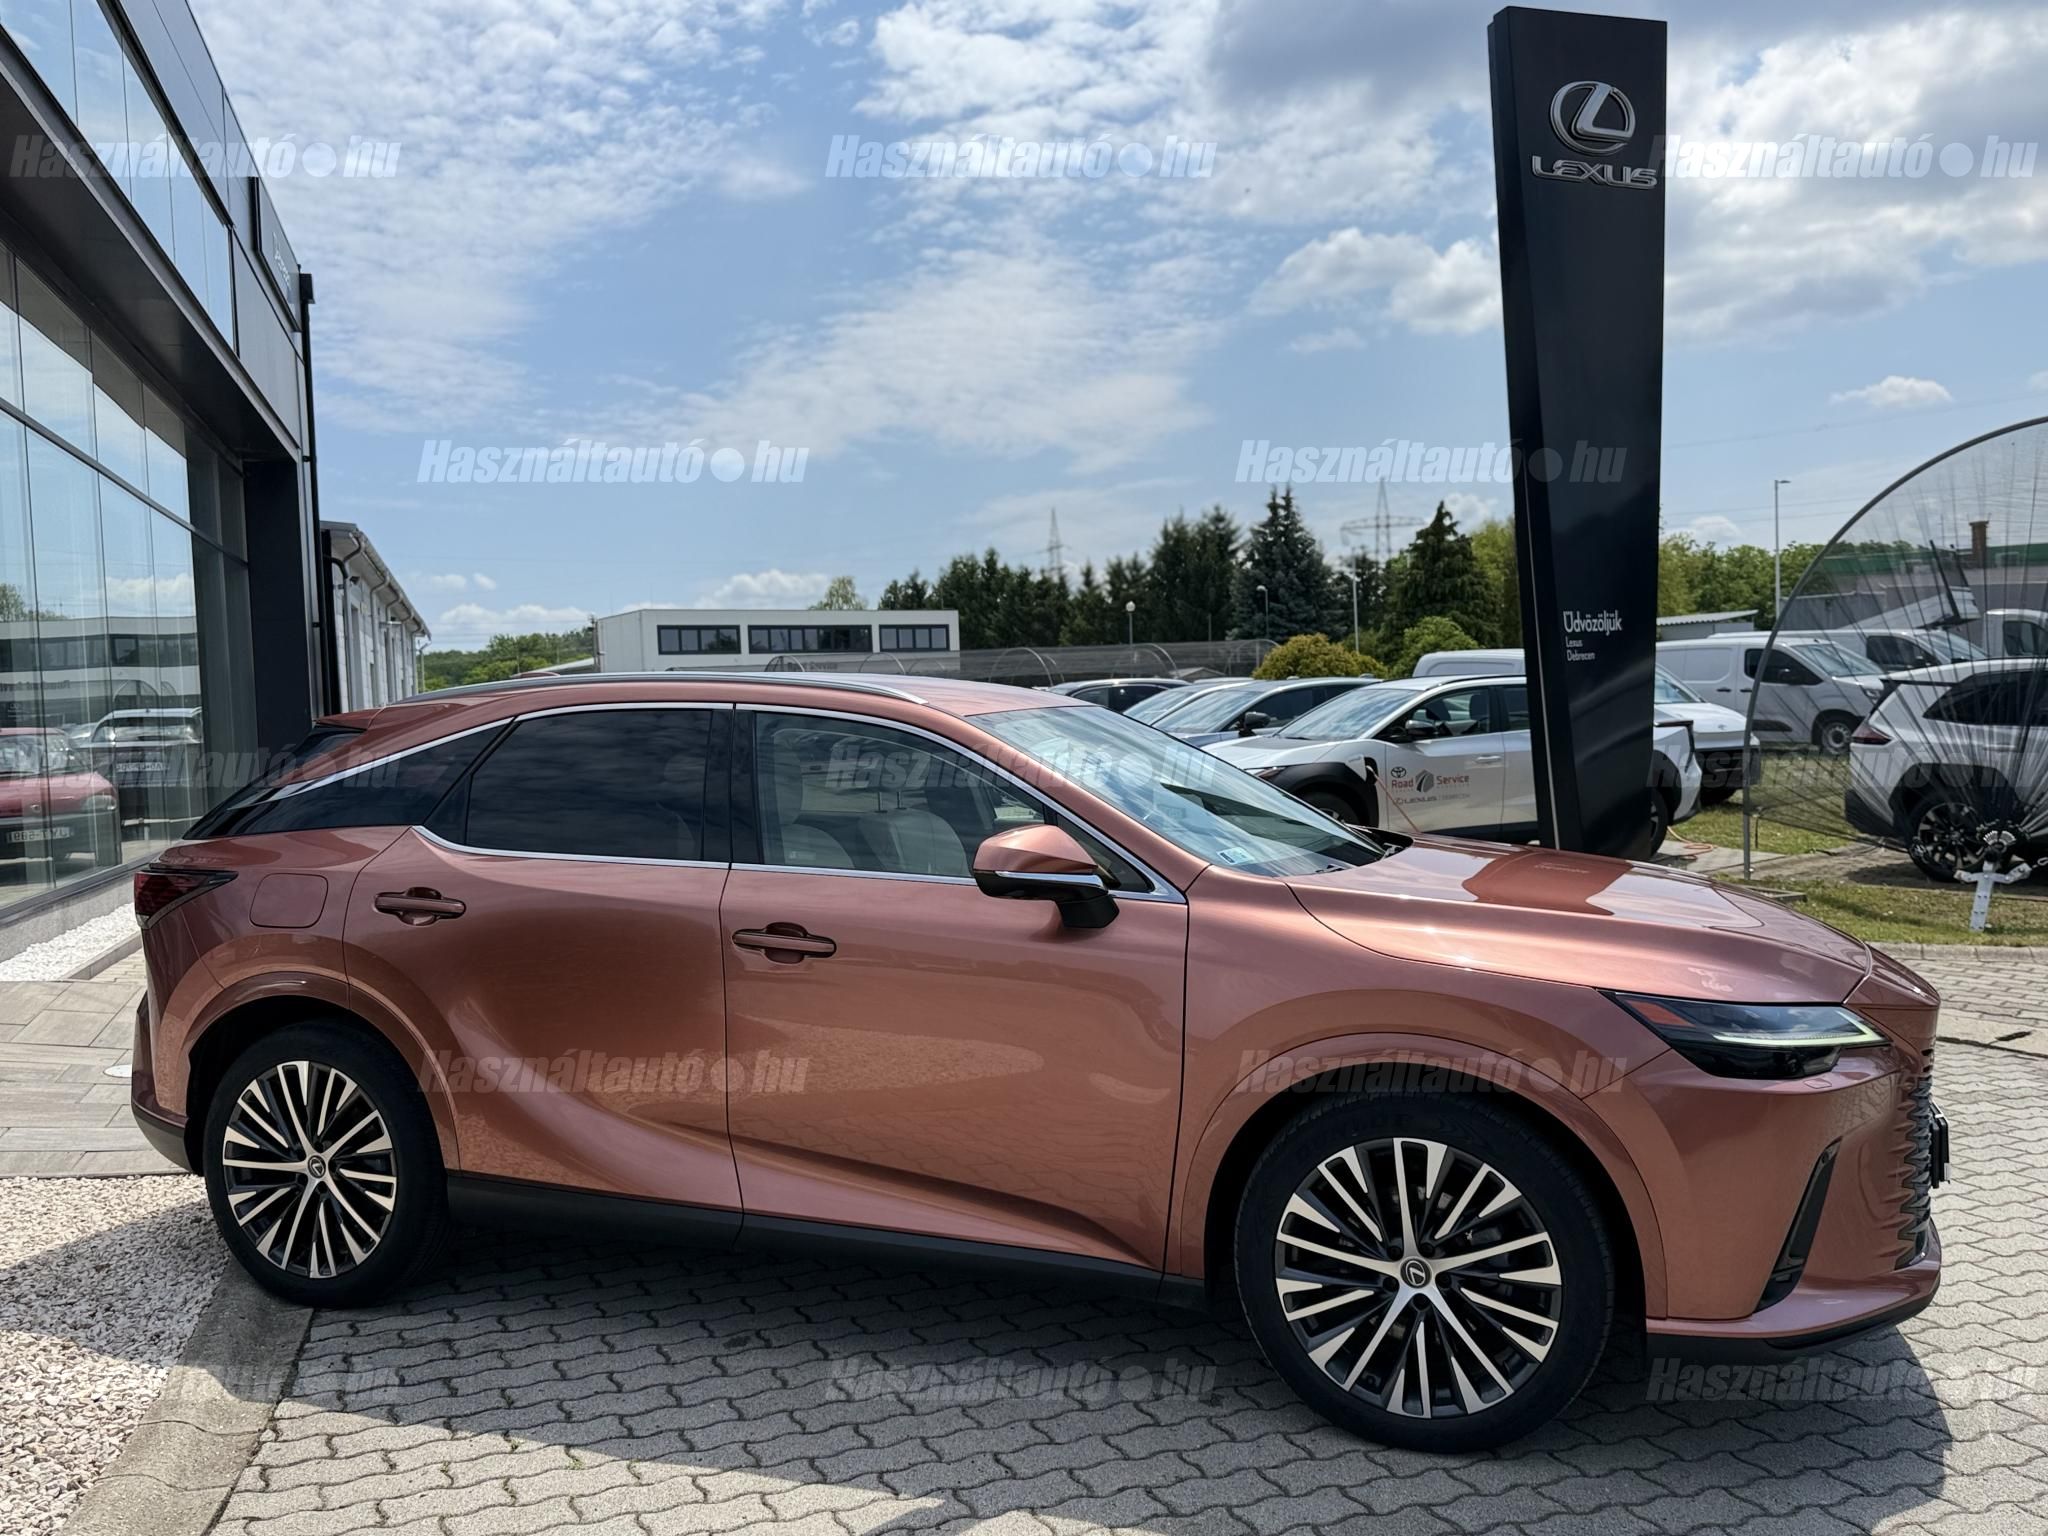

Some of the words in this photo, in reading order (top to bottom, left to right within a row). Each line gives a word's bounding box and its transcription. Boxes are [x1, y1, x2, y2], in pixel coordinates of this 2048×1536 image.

[1531, 155, 1658, 190] LEXUS
[1563, 609, 1623, 636] Üdvözöljük
[1391, 778, 1414, 789] Road
[1436, 773, 1470, 785] Service
